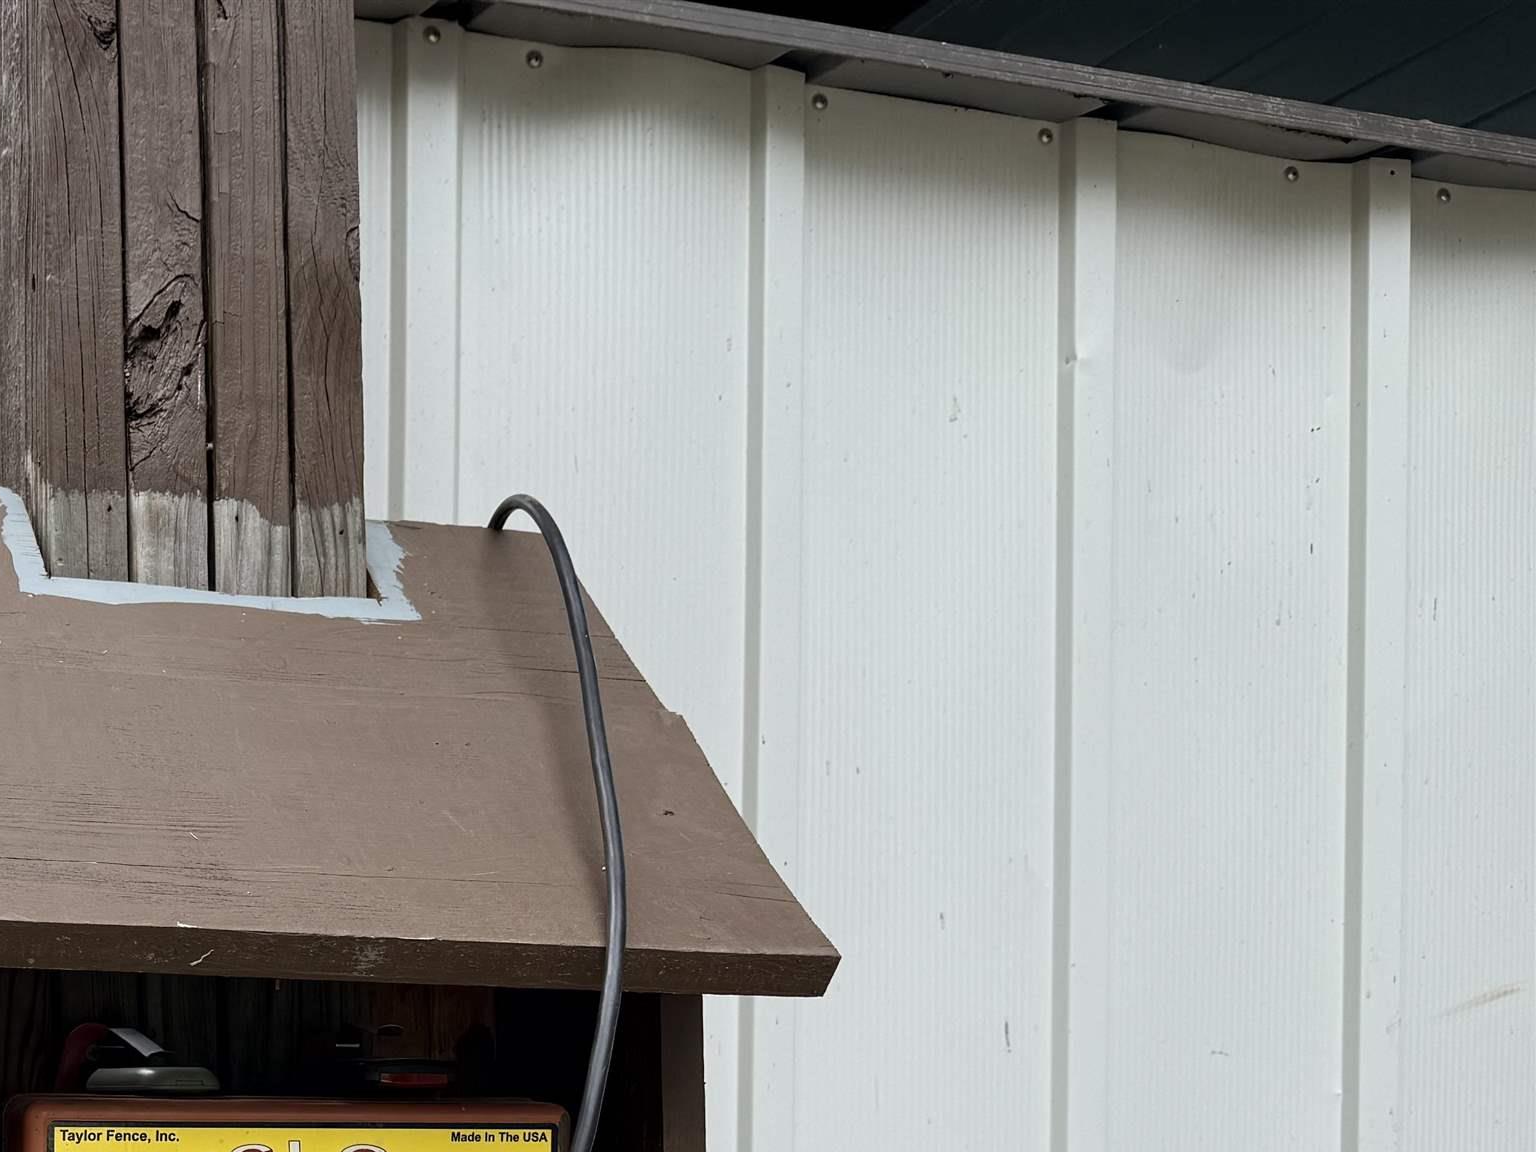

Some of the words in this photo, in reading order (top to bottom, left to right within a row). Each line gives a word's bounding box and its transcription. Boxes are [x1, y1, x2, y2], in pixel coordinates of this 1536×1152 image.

[60, 1129, 102, 1144] Taylor
[106, 1129, 151, 1144] Fence,
[156, 1129, 180, 1142] Inc.
[451, 1131, 482, 1143] Made
[485, 1132, 495, 1142] In
[499, 1132, 520, 1143] The
[523, 1132, 548, 1143] USA
